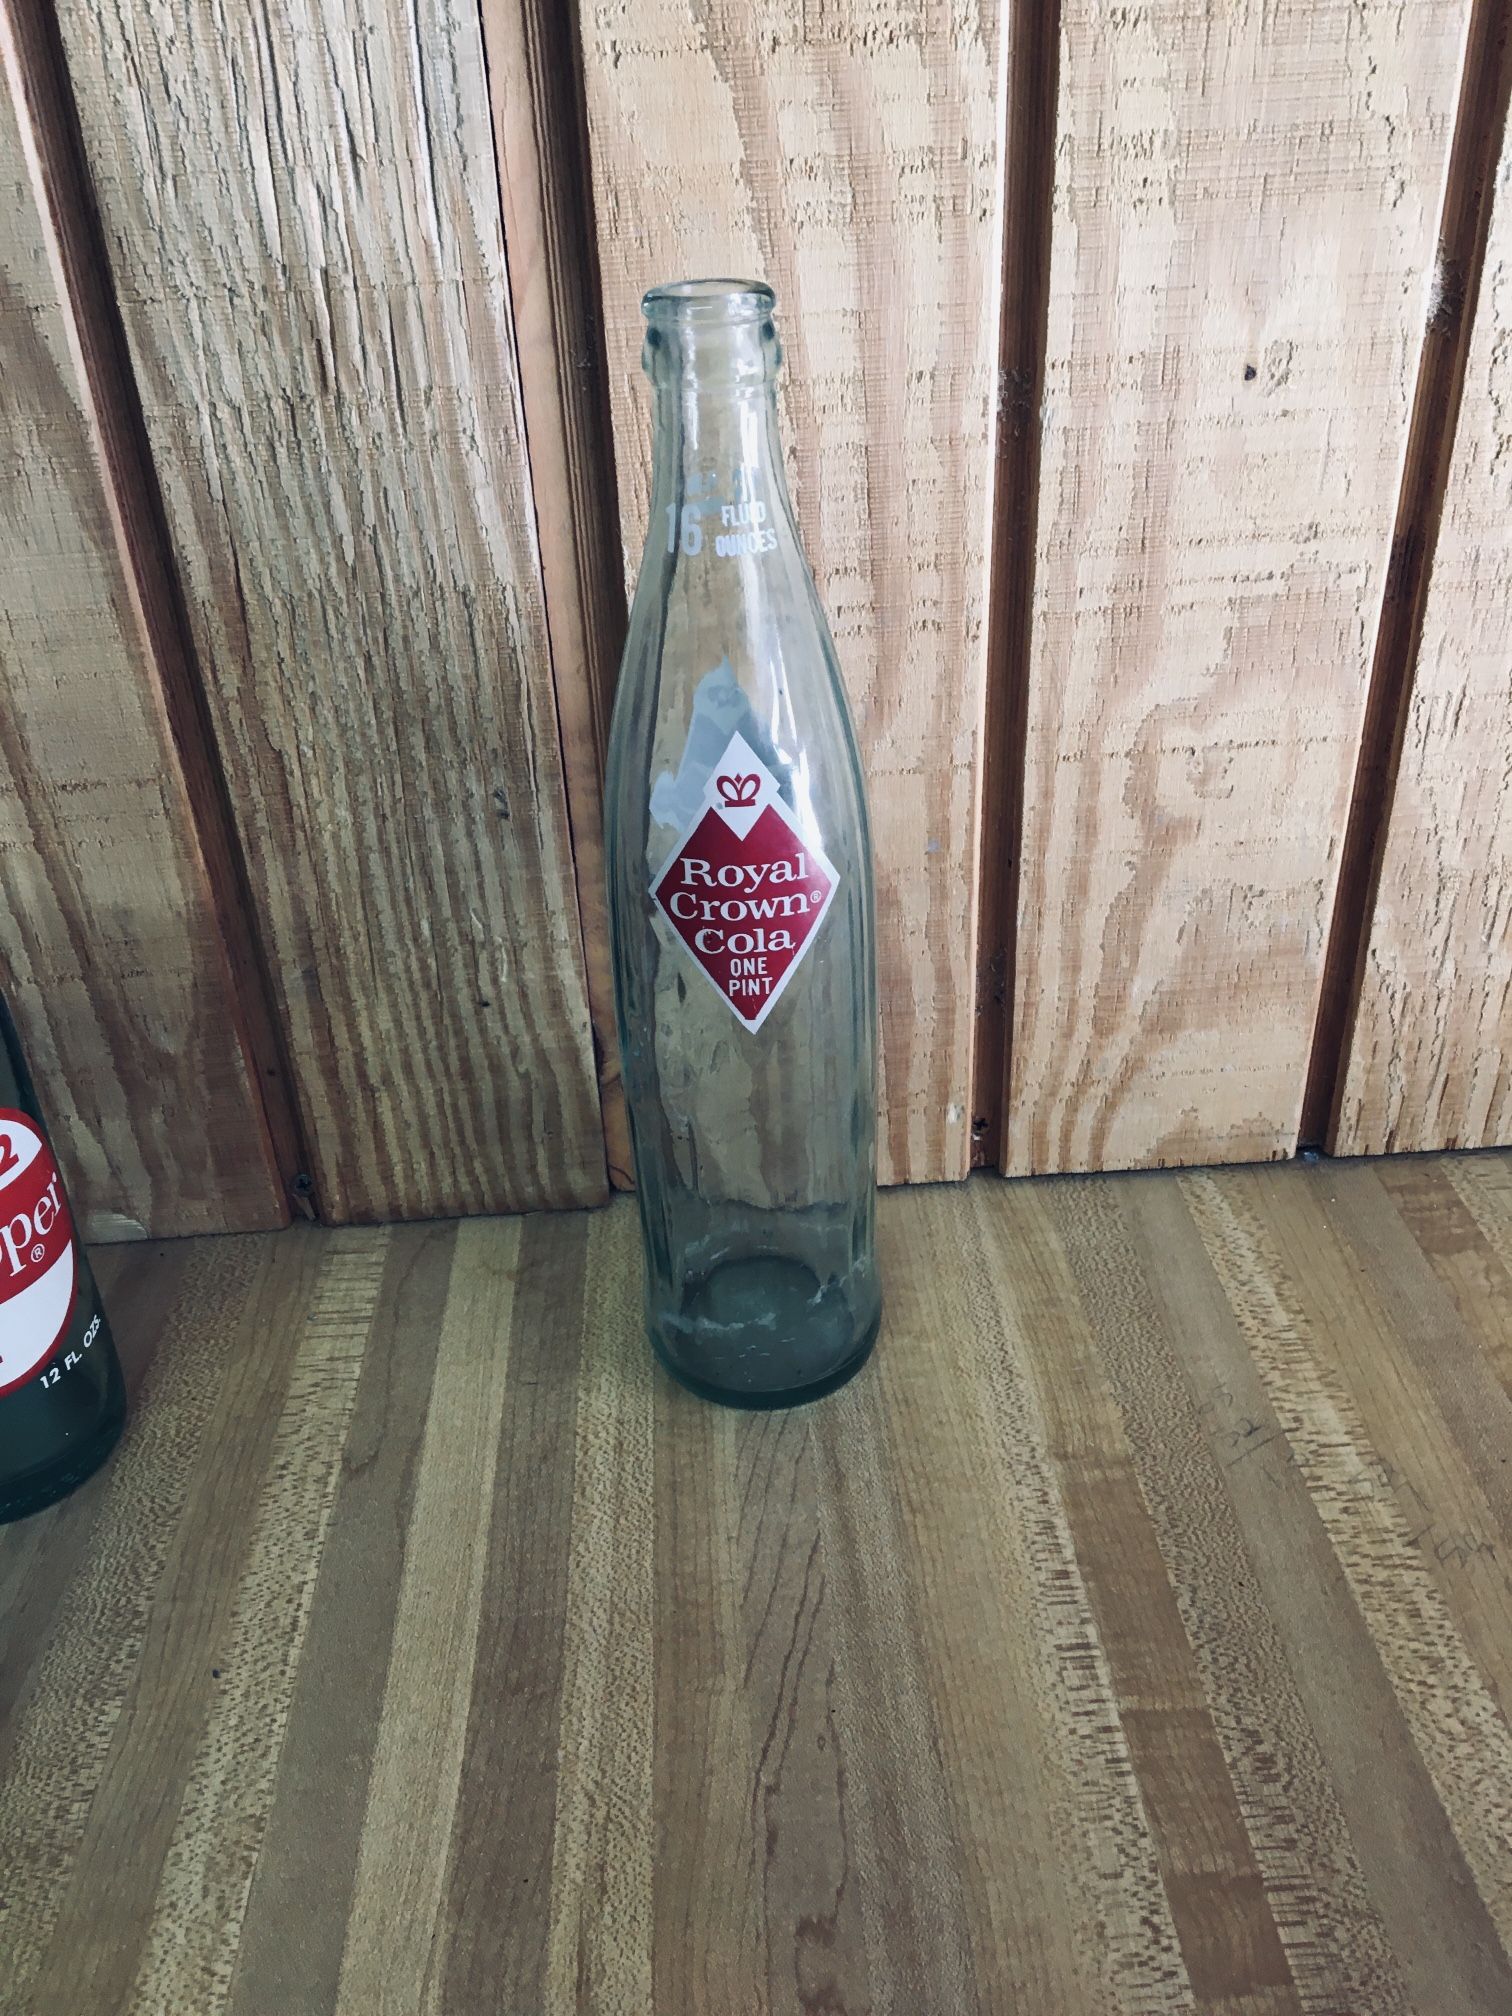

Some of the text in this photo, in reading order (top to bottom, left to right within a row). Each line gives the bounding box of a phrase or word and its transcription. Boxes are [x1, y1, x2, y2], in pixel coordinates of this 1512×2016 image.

[721, 501, 766, 527] FLUID
[665, 502, 702, 556] 16
[715, 528, 778, 557] OUNCES
[680, 853, 809, 894] Royal
[694, 928, 796, 954] Cola
[730, 957, 768, 977] ONE
[728, 977, 773, 997] PINT
[40, 1367, 61, 1389] 12
